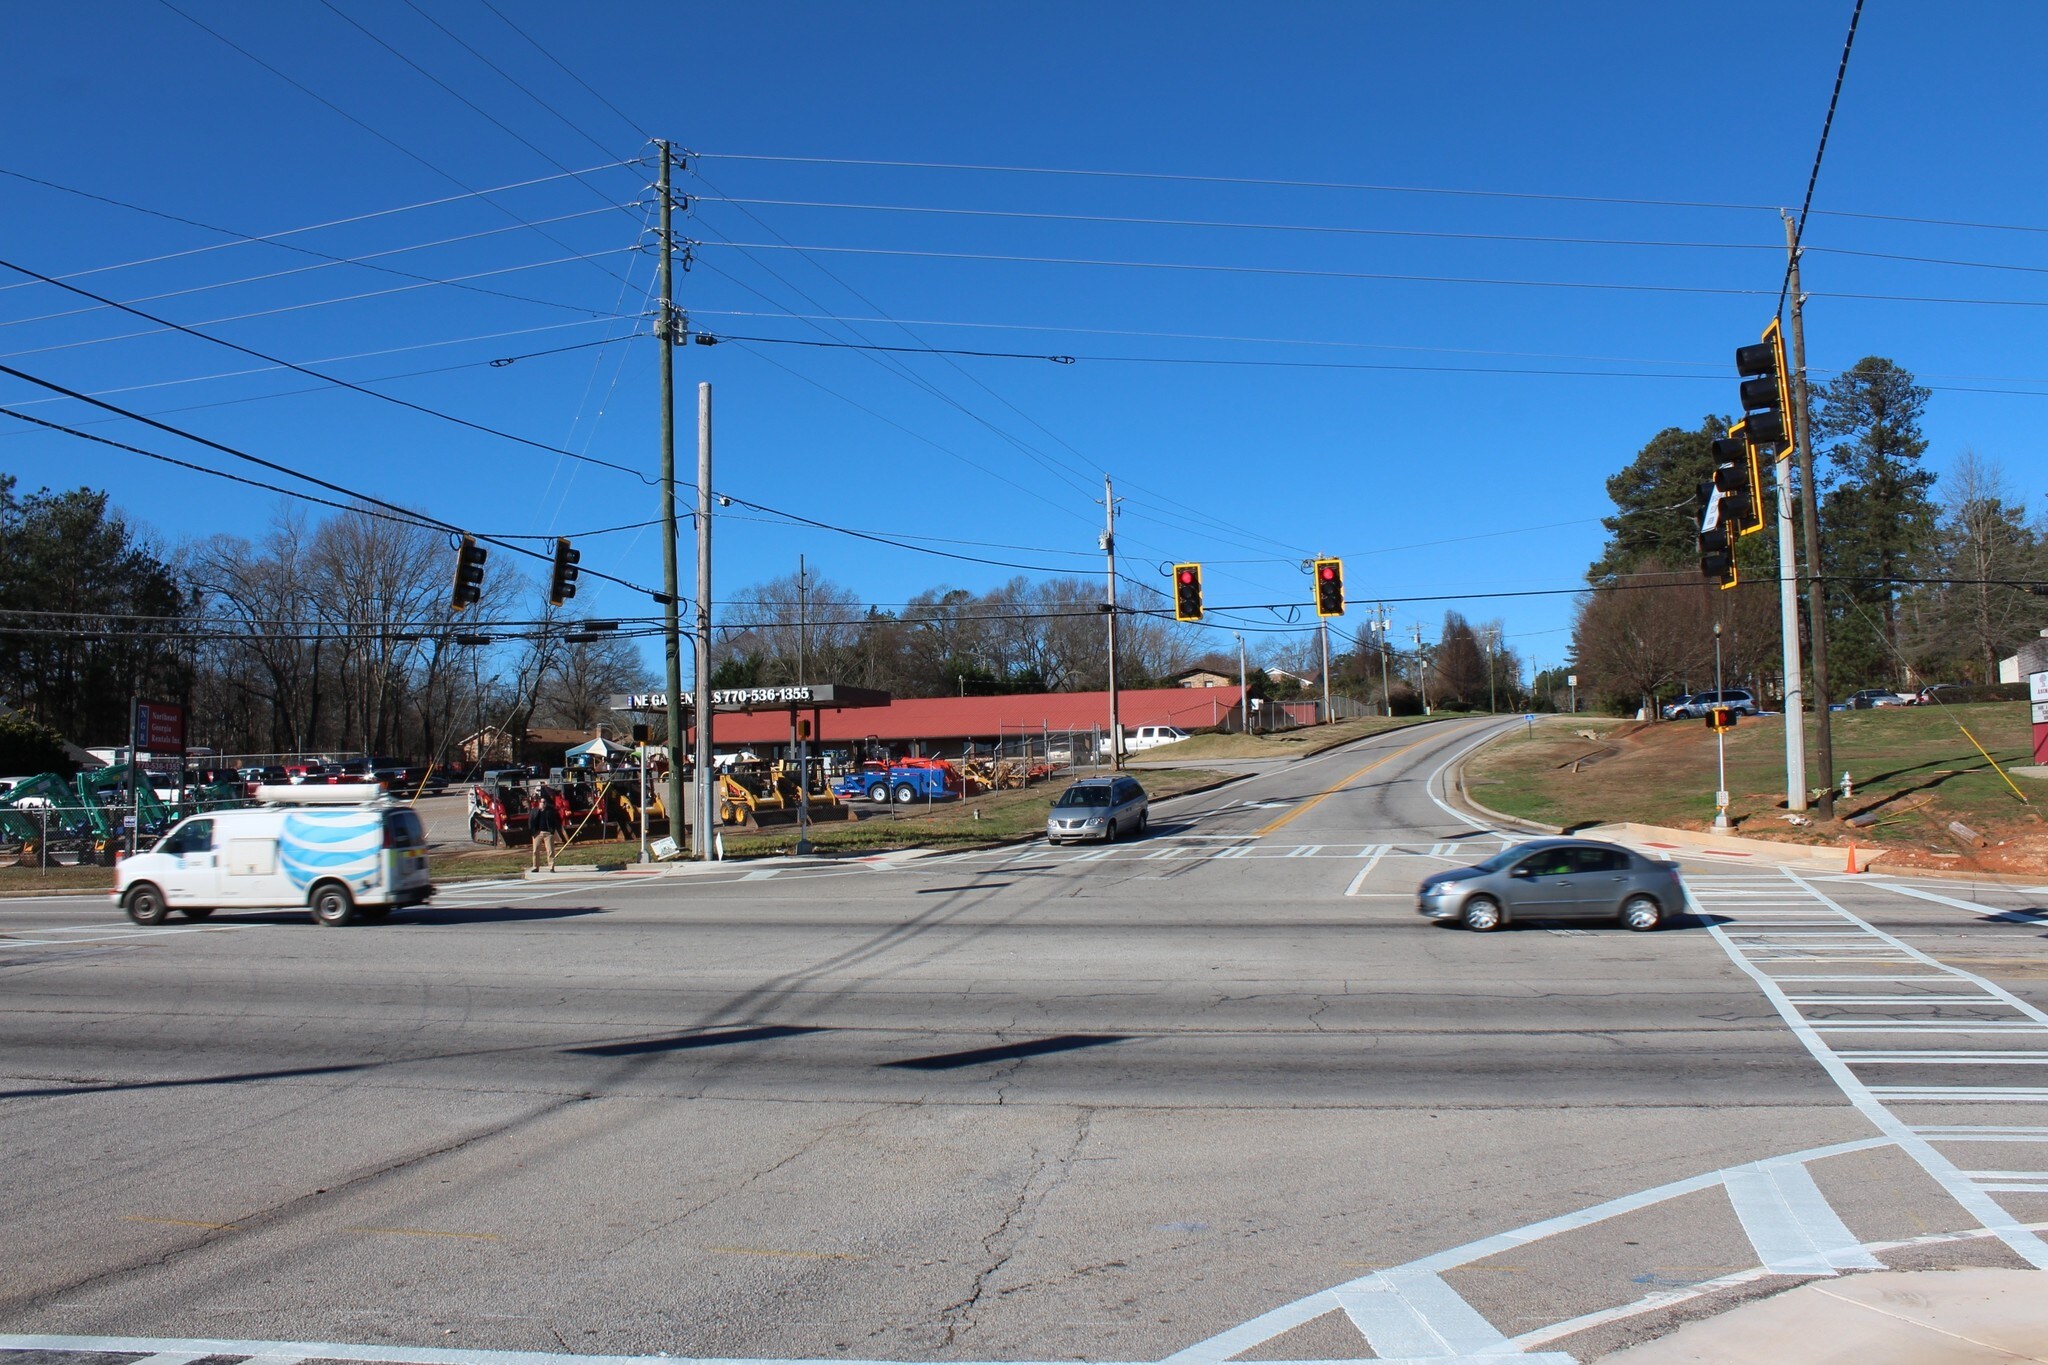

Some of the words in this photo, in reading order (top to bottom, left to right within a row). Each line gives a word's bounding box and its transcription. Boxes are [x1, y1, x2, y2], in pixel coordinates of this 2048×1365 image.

[634, 694, 649, 706] NE
[723, 687, 809, 702] 770-536-1355
[152, 711, 177, 721] Northeast
[151, 723, 171, 733] Georgia
[151, 734, 171, 743] Rentals
